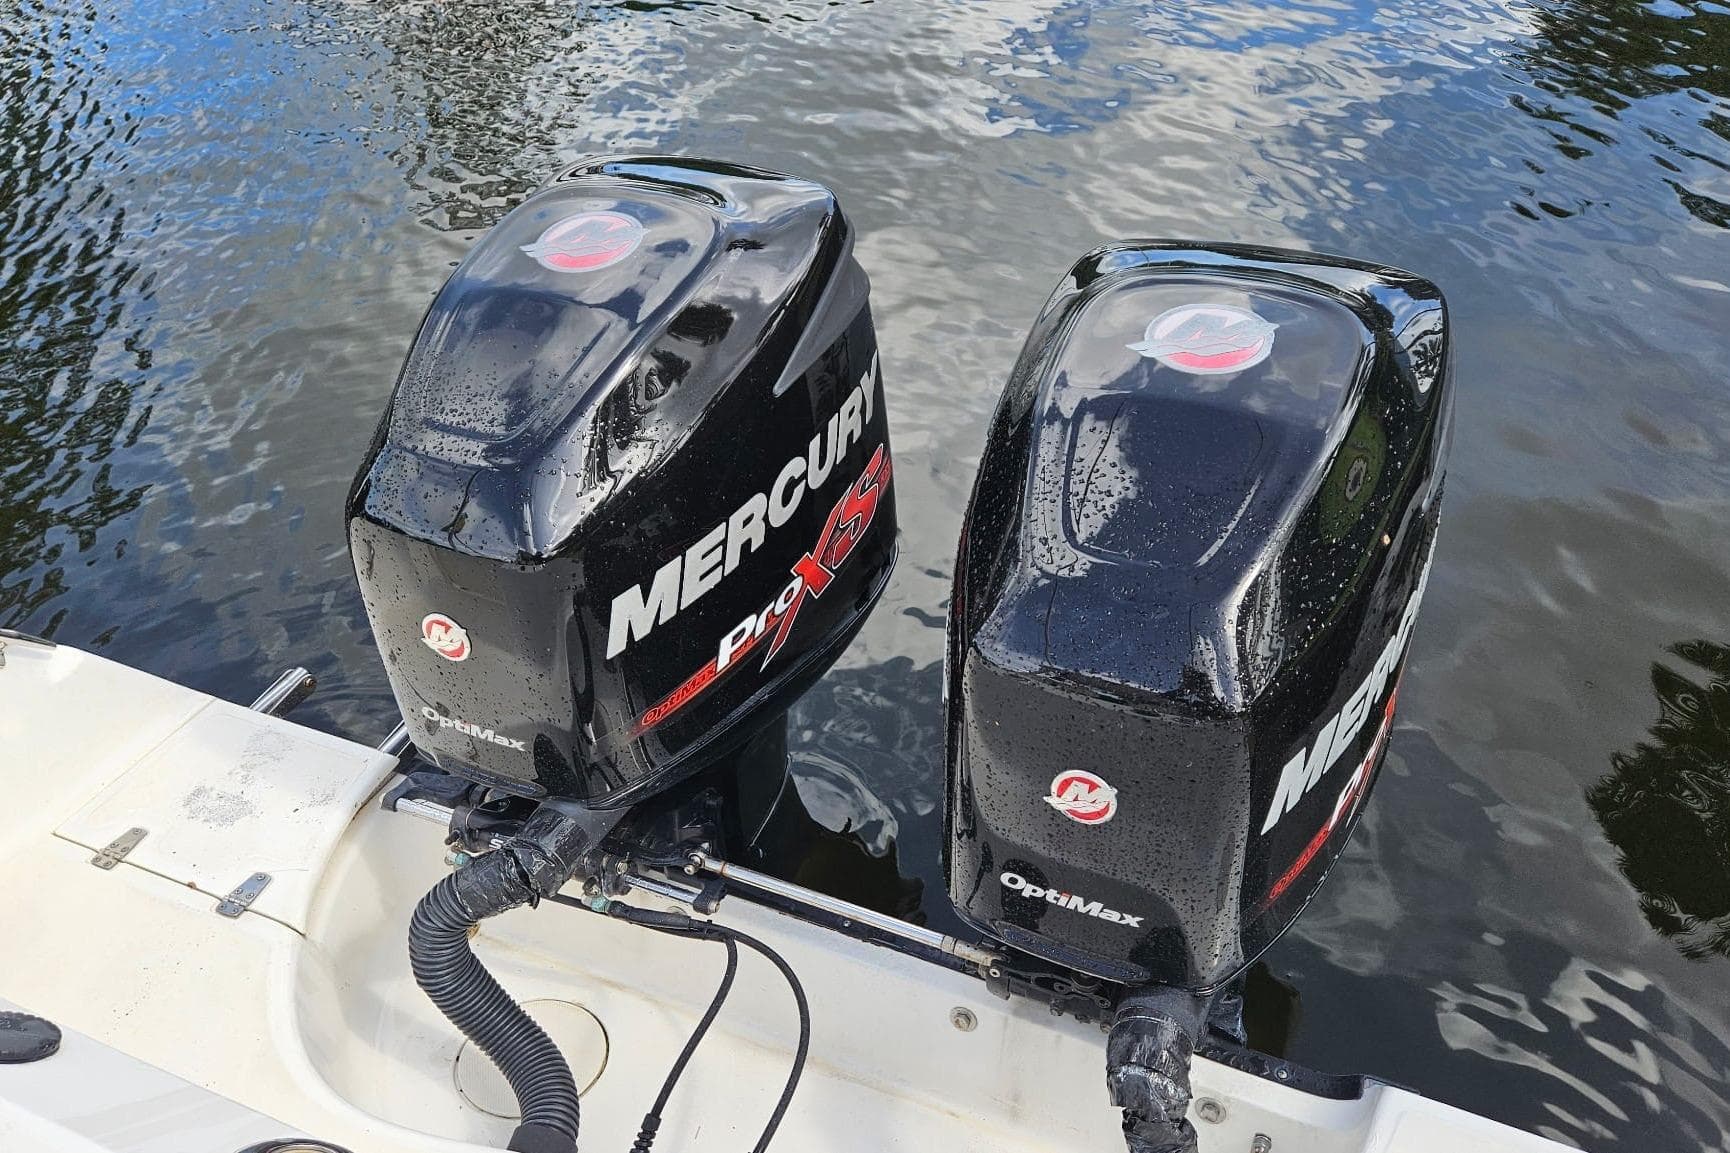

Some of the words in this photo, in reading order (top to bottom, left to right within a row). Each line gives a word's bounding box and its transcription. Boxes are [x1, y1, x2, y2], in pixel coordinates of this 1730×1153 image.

[606, 350, 879, 660] MERCURY
[421, 706, 526, 752] OptiMax
[1000, 871, 1145, 928] OptiMax
